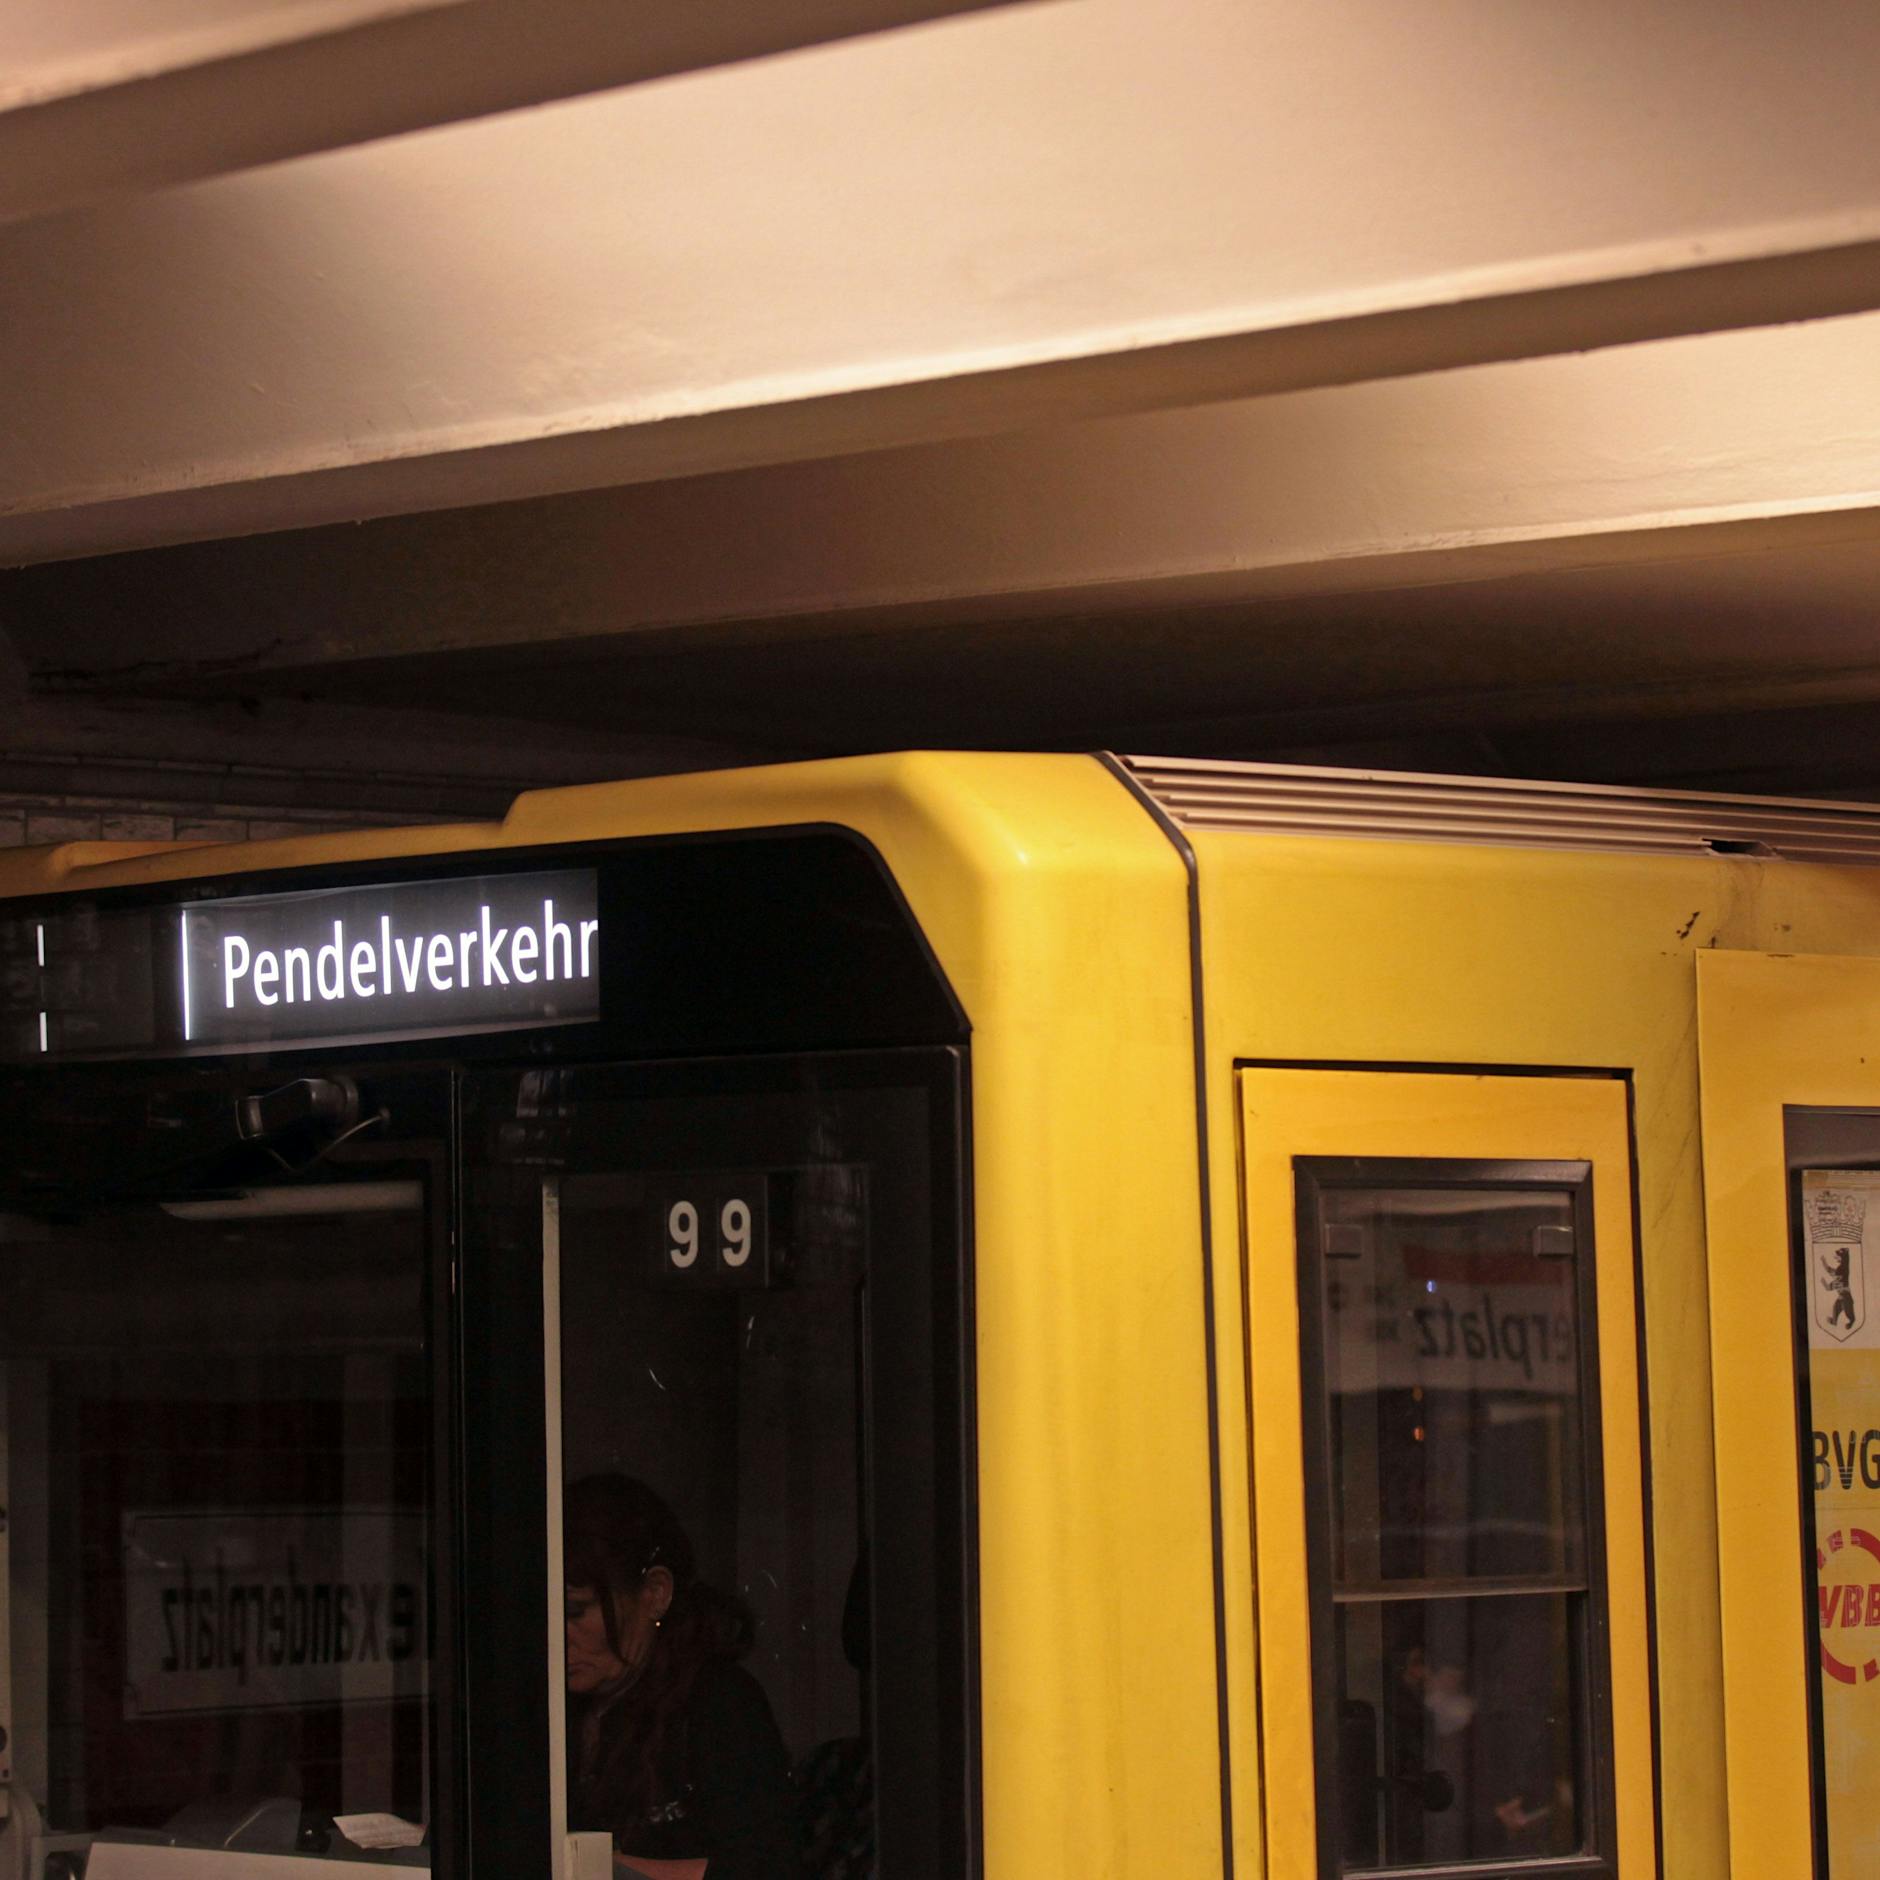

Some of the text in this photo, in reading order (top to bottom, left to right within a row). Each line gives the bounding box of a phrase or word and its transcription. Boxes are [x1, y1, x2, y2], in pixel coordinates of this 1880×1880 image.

[224, 899, 599, 1008] Pendelverkehr
[1812, 1428, 1880, 1490] BVG
[1817, 1583, 1880, 1629] VBB
